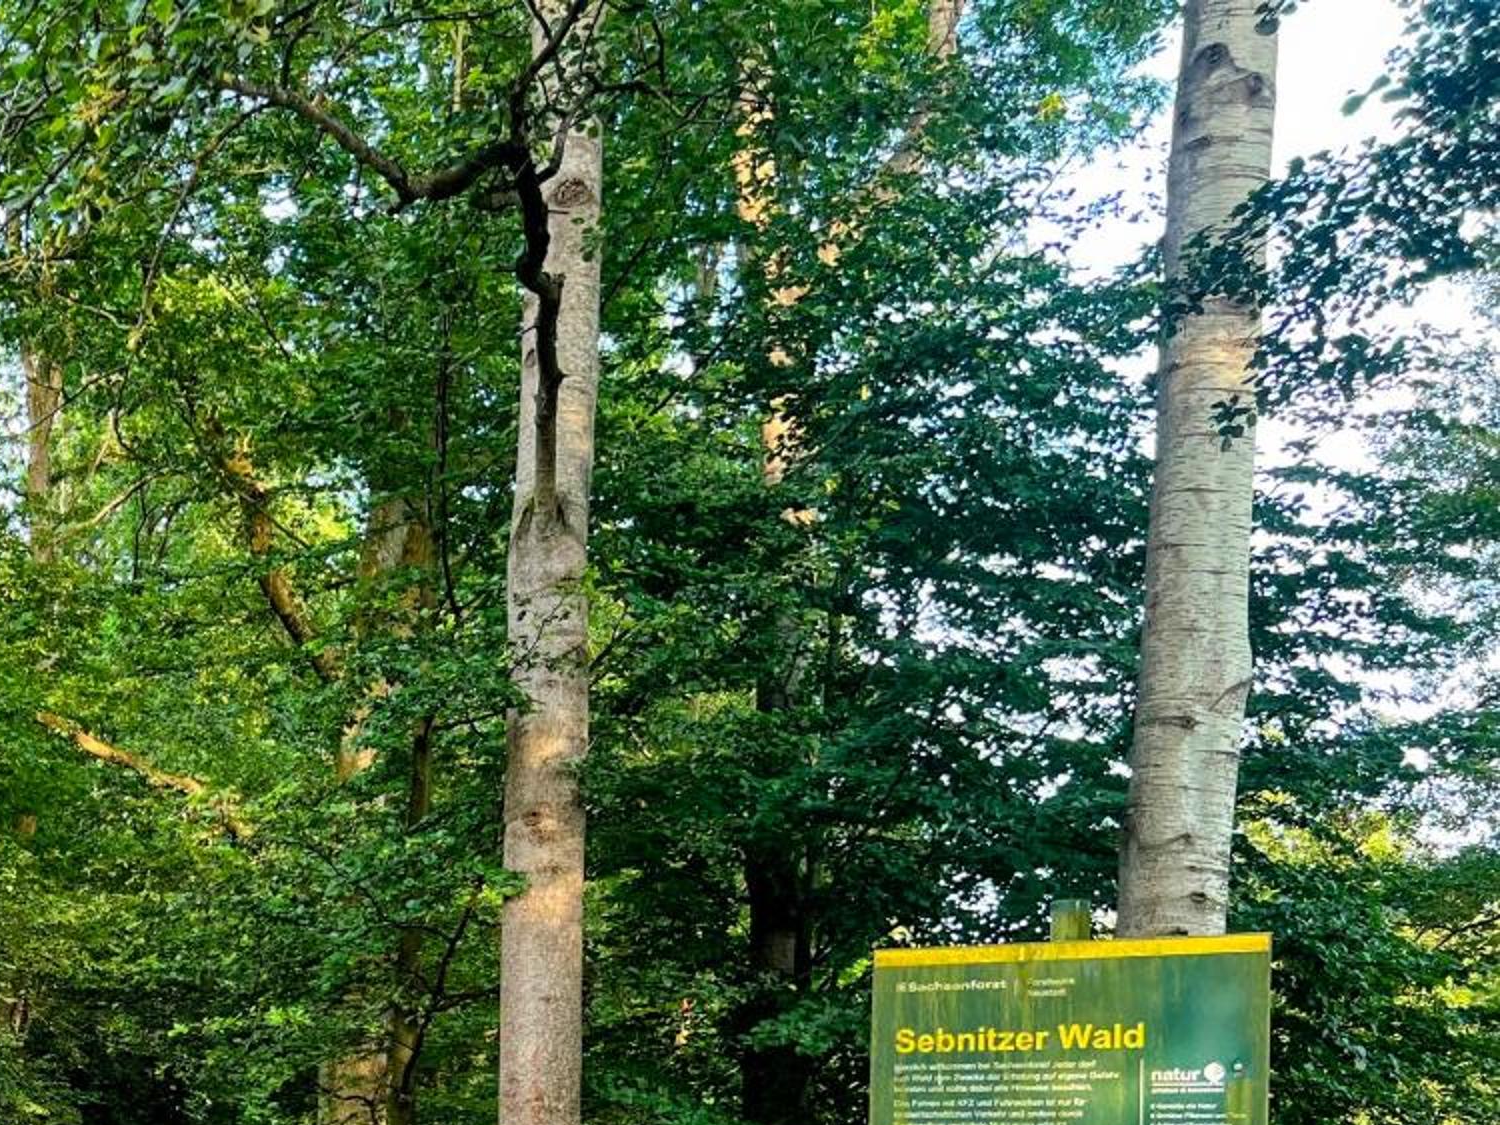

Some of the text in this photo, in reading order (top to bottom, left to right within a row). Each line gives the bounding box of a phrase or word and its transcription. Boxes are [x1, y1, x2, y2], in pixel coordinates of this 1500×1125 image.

[908, 979, 1007, 993] Sachsenforst
[895, 1022, 1145, 1053] Sebnitzer Wald
[1151, 1067, 1202, 1081] natur
